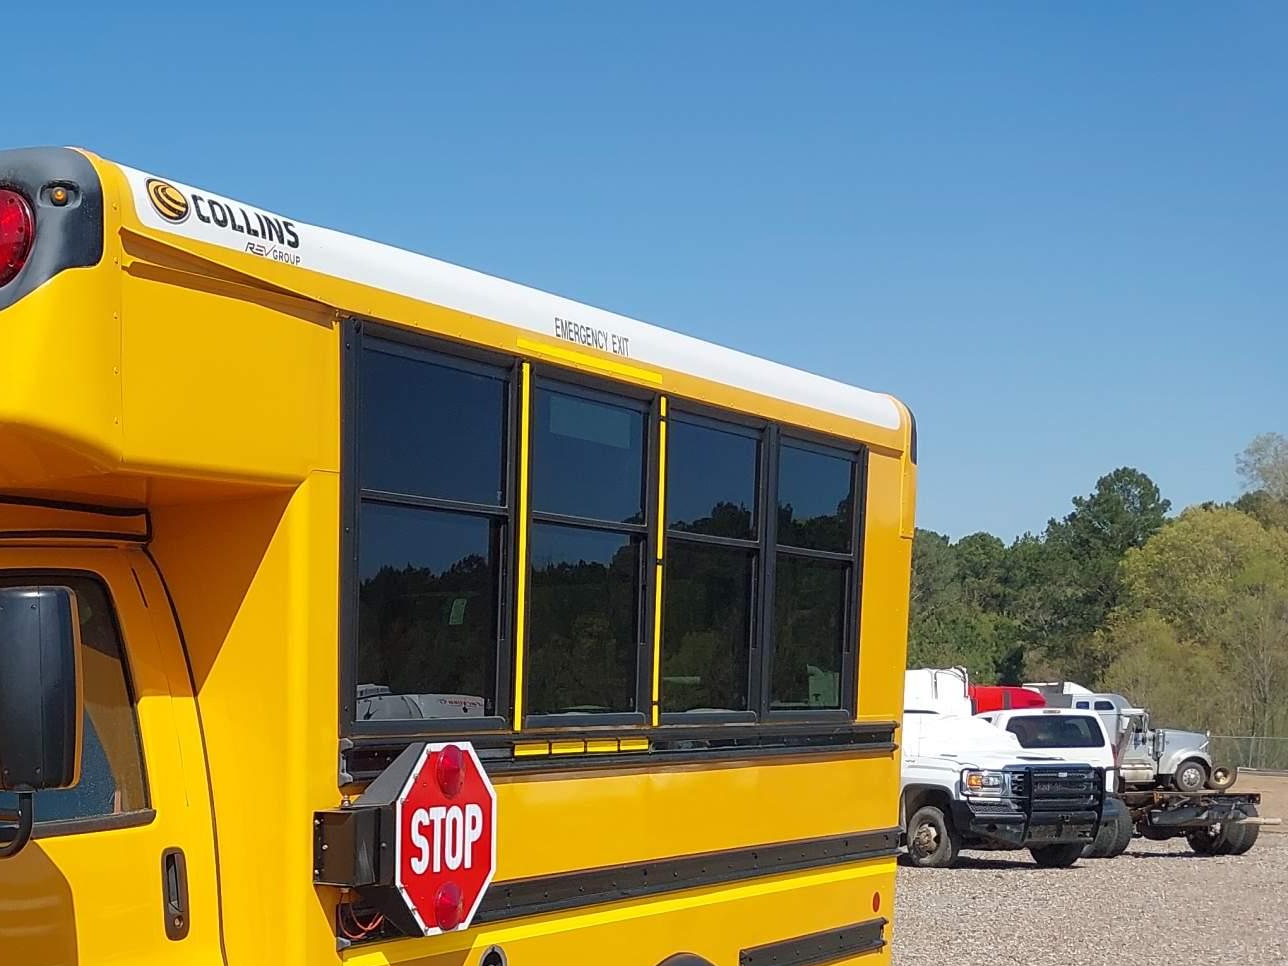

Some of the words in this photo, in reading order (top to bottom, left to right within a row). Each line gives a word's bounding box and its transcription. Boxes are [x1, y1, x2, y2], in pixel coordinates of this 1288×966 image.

[191, 193, 300, 248] COLLINS
[244, 242, 276, 256] REV
[272, 249, 301, 265] GROUP
[554, 317, 608, 351] EMERGENCY
[611, 334, 630, 357] EXIT
[410, 803, 483, 875] STOP
